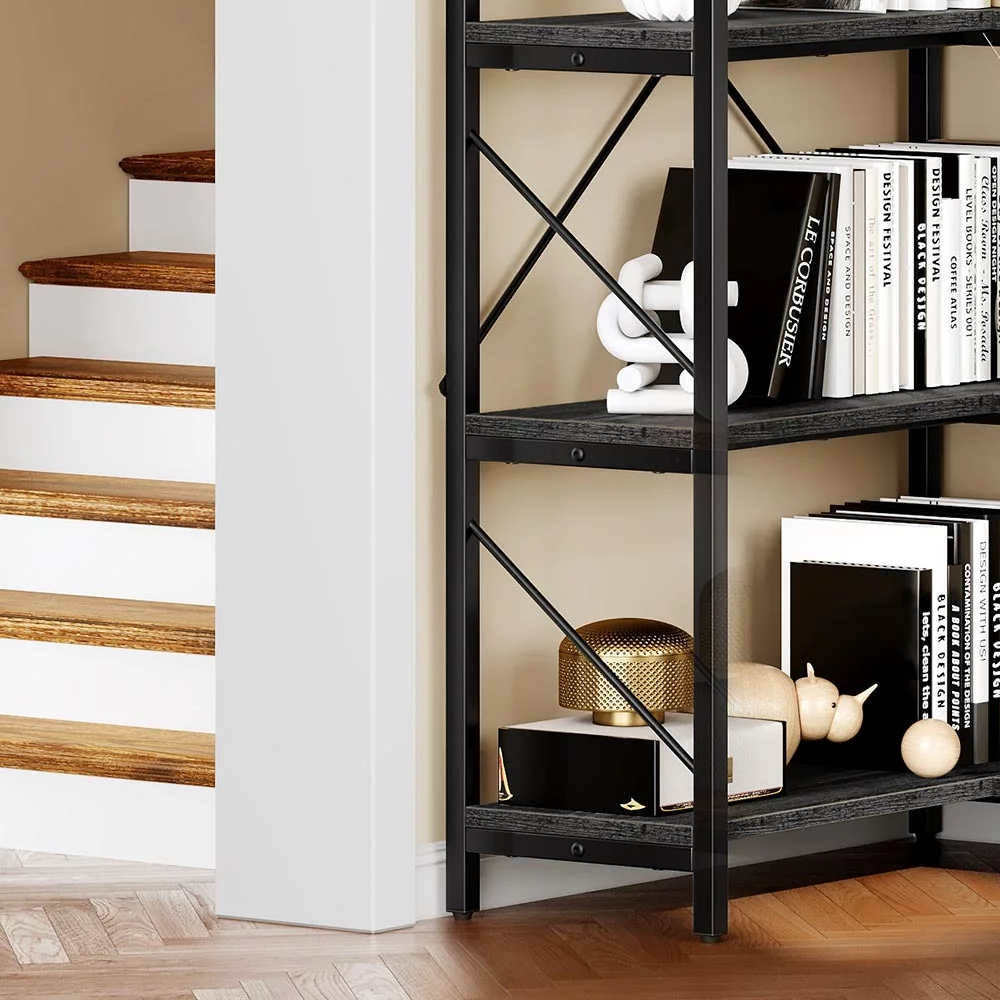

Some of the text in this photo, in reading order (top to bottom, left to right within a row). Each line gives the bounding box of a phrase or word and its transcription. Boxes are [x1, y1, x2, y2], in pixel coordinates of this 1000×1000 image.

[883, 173, 891, 288] DESIGN FESTIVAL
[917, 223, 926, 331] BLACK DESIGN
[932, 168, 940, 283] DESIGN FESTIVAL
[778, 215, 820, 368] LE CORBUSIER
[821, 231, 836, 341] SPACE AND DESIGN
[921, 611, 931, 641] lets,
[922, 645, 931, 683] clean
[937, 594, 946, 708] BLACK DESIGN
[951, 604, 960, 731] A BOOK ABOUT POINTS
[964, 652, 970, 666] OF
[922, 686, 931, 710] the
